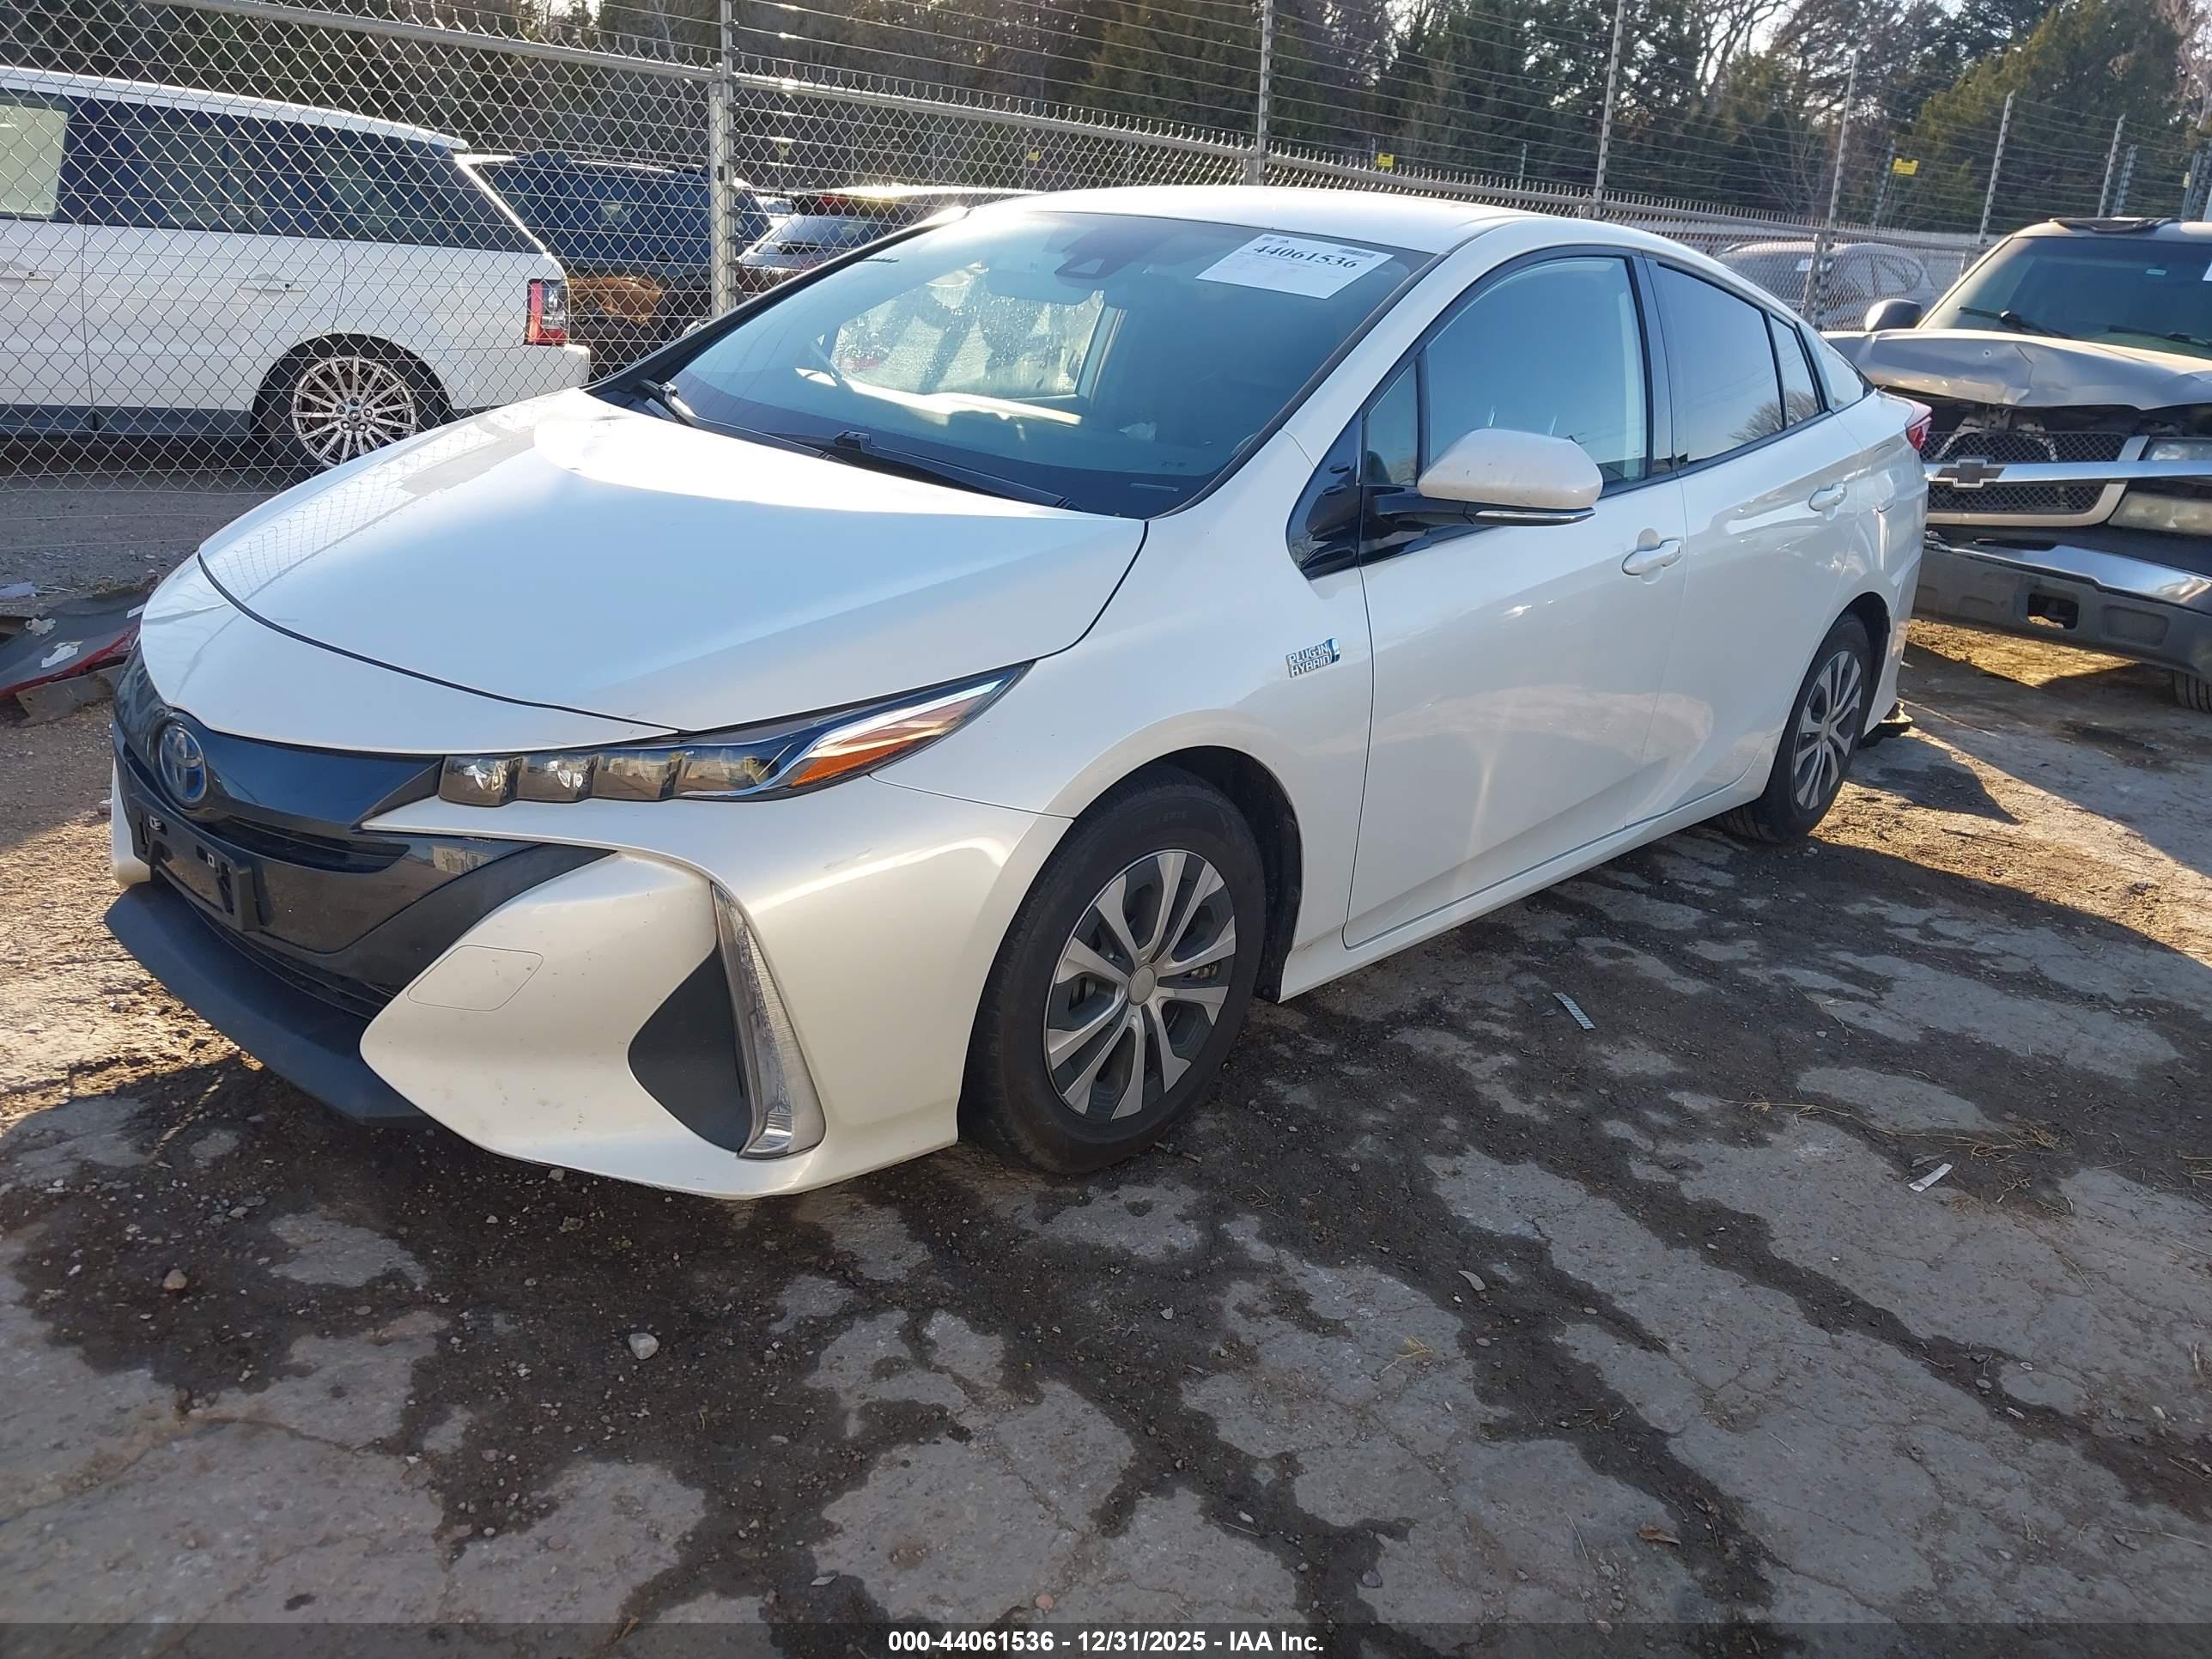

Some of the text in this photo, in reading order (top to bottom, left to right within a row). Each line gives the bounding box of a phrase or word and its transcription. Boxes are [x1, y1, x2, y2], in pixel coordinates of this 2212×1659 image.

[1255, 246, 1358, 268] 44061536
[1290, 643, 1328, 665] PLUG-IN
[1291, 655, 1331, 677] HYBRID
